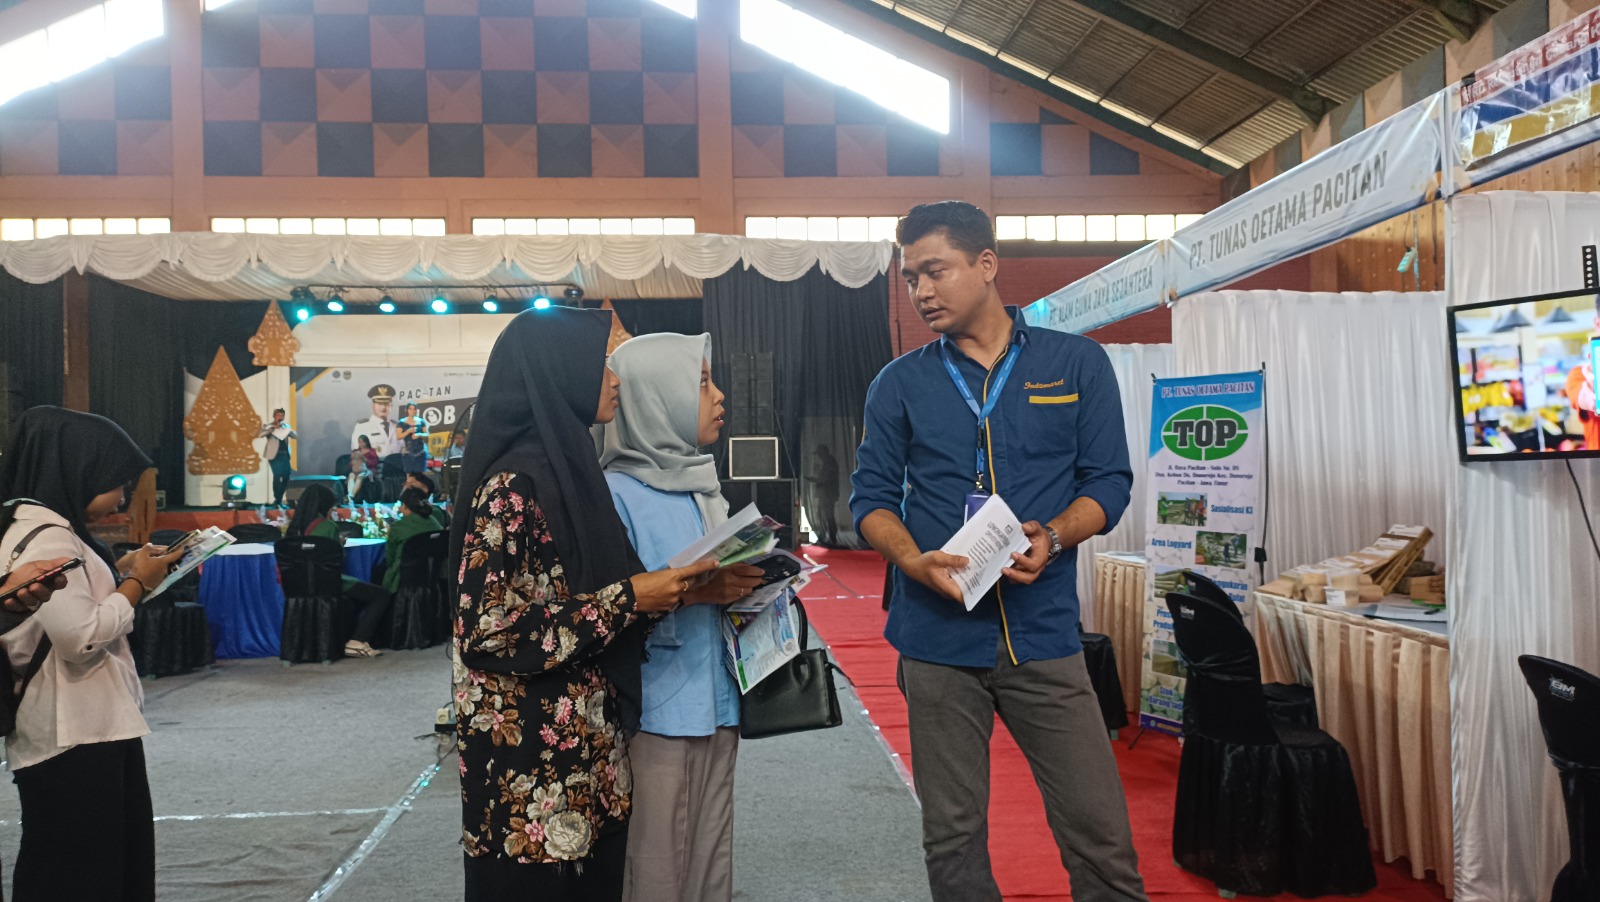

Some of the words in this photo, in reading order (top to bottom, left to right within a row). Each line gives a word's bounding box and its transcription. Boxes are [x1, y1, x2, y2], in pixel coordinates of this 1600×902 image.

[1189, 240, 1206, 270] PT.
[1210, 219, 1247, 262] TUNAS
[1251, 191, 1307, 244] OETAMA
[1312, 151, 1388, 218] PACITAN
[1112, 266, 1152, 303] SEJAHTERA
[1174, 385, 1194, 397] TUNAS
[1224, 382, 1254, 394] PACITAN
[1173, 419, 1237, 447] TOP
[1211, 504, 1245, 514] Sosialisasi
[1152, 538, 1165, 547] Area
[1167, 540, 1192, 549] Logyard
